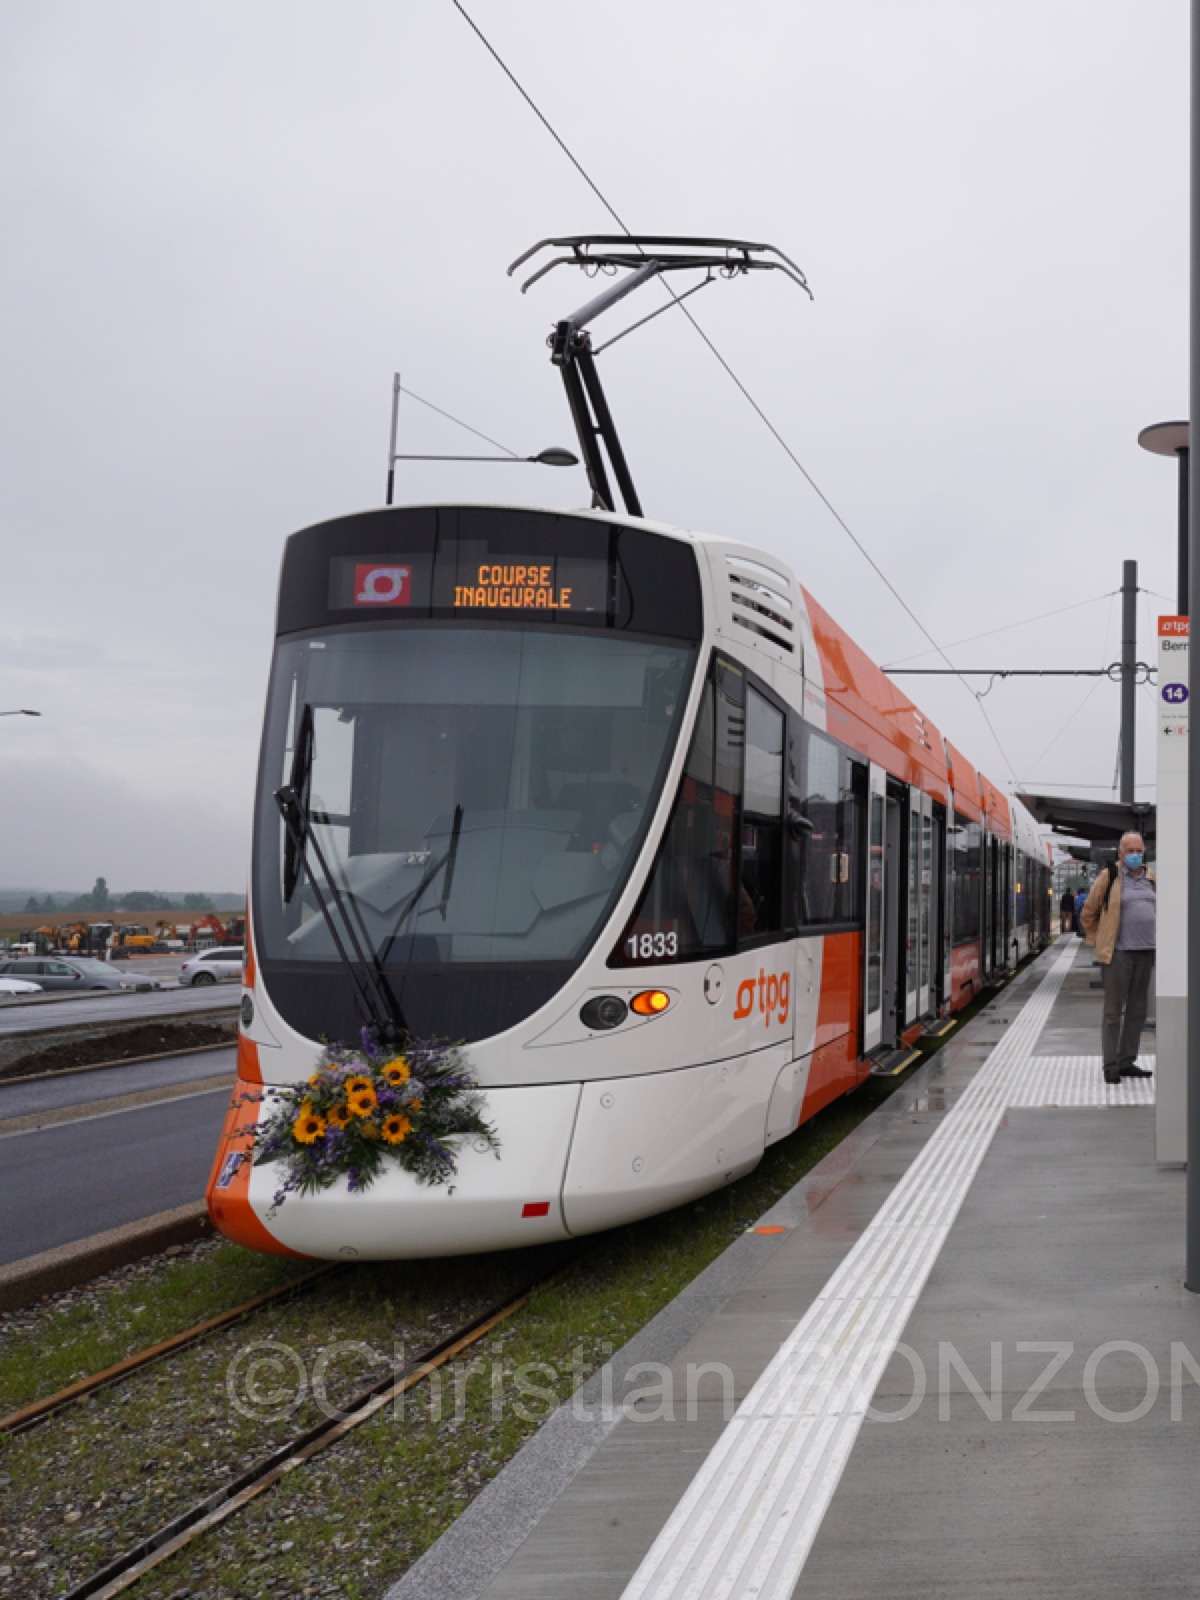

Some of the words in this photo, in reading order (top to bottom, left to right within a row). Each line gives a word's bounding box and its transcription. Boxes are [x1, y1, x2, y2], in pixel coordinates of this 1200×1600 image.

[478, 565, 552, 586] COURSE
[453, 586, 573, 608] INAUGURALE
[1165, 687, 1184, 700] 14
[627, 932, 677, 959] 1833
